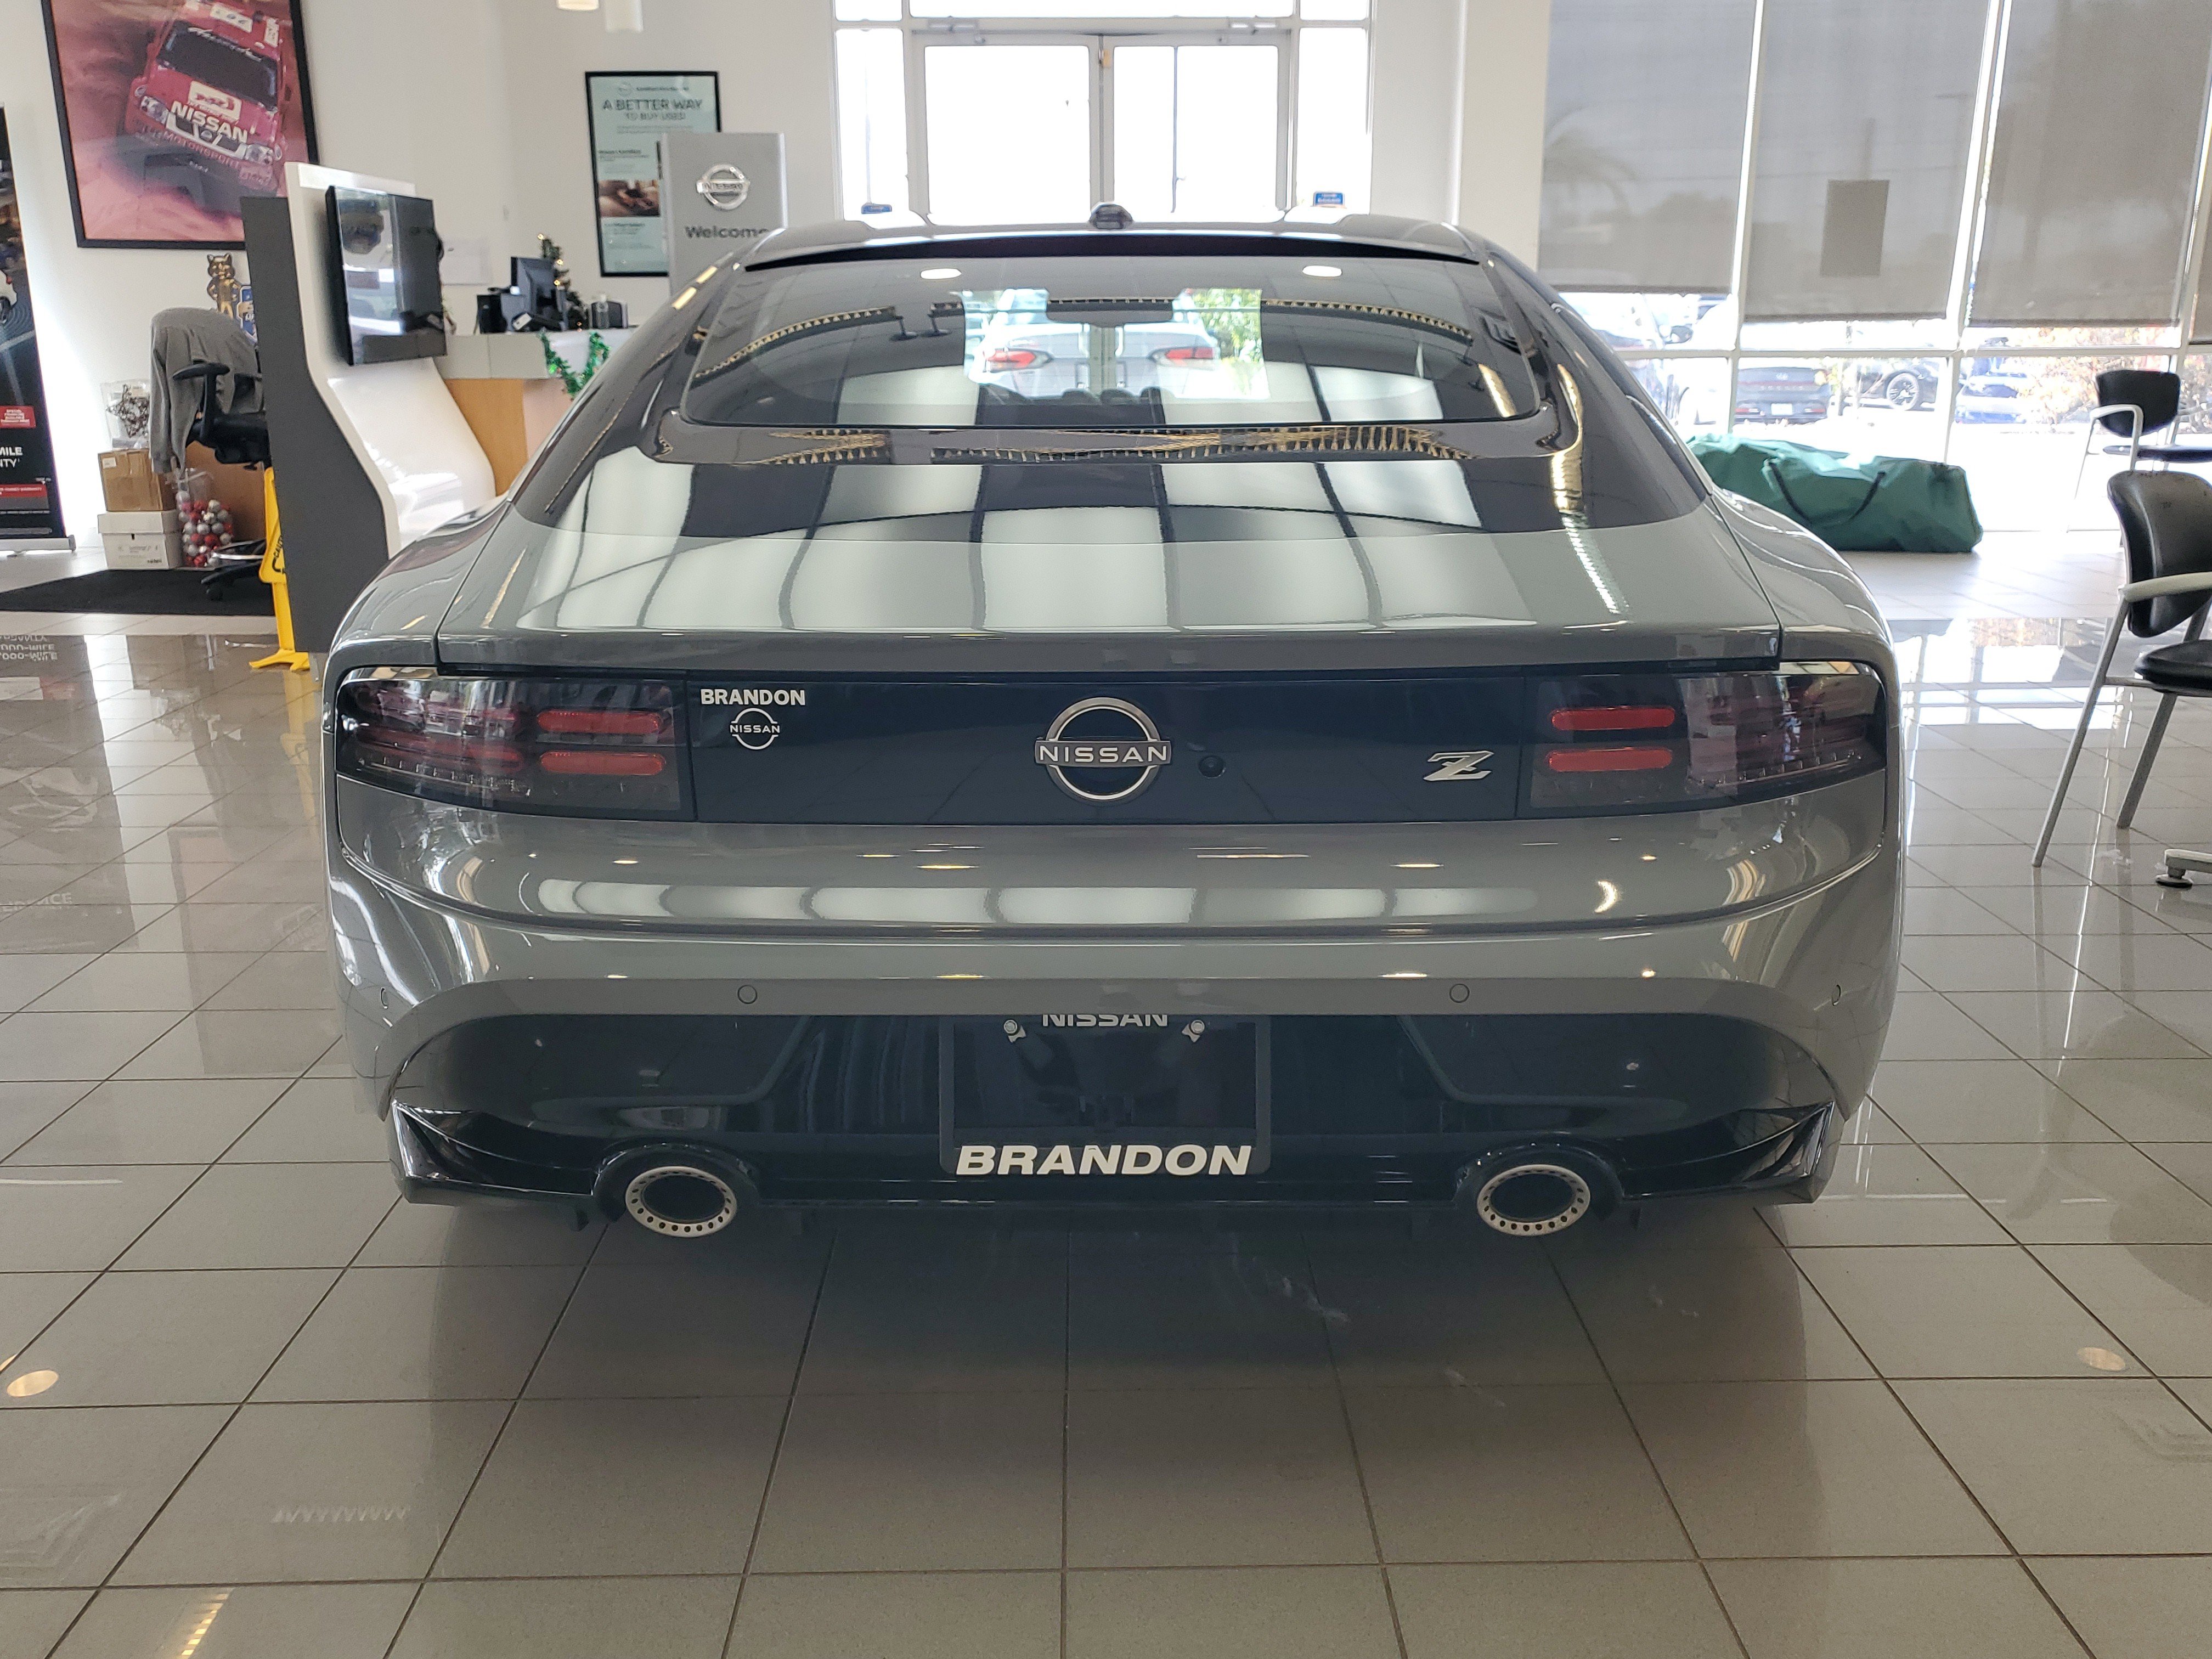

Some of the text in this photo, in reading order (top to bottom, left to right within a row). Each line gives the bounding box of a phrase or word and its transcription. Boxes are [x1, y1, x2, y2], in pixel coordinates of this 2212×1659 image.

[603, 99, 702, 110] A BETTER WAY
[171, 100, 249, 143] NISSAN
[700, 689, 806, 706] BRANDON
[729, 724, 781, 733] NISSAN
[1039, 745, 1167, 763] NISSAN
[1423, 750, 1495, 782] Z
[956, 1144, 1252, 1175] BRANDON
